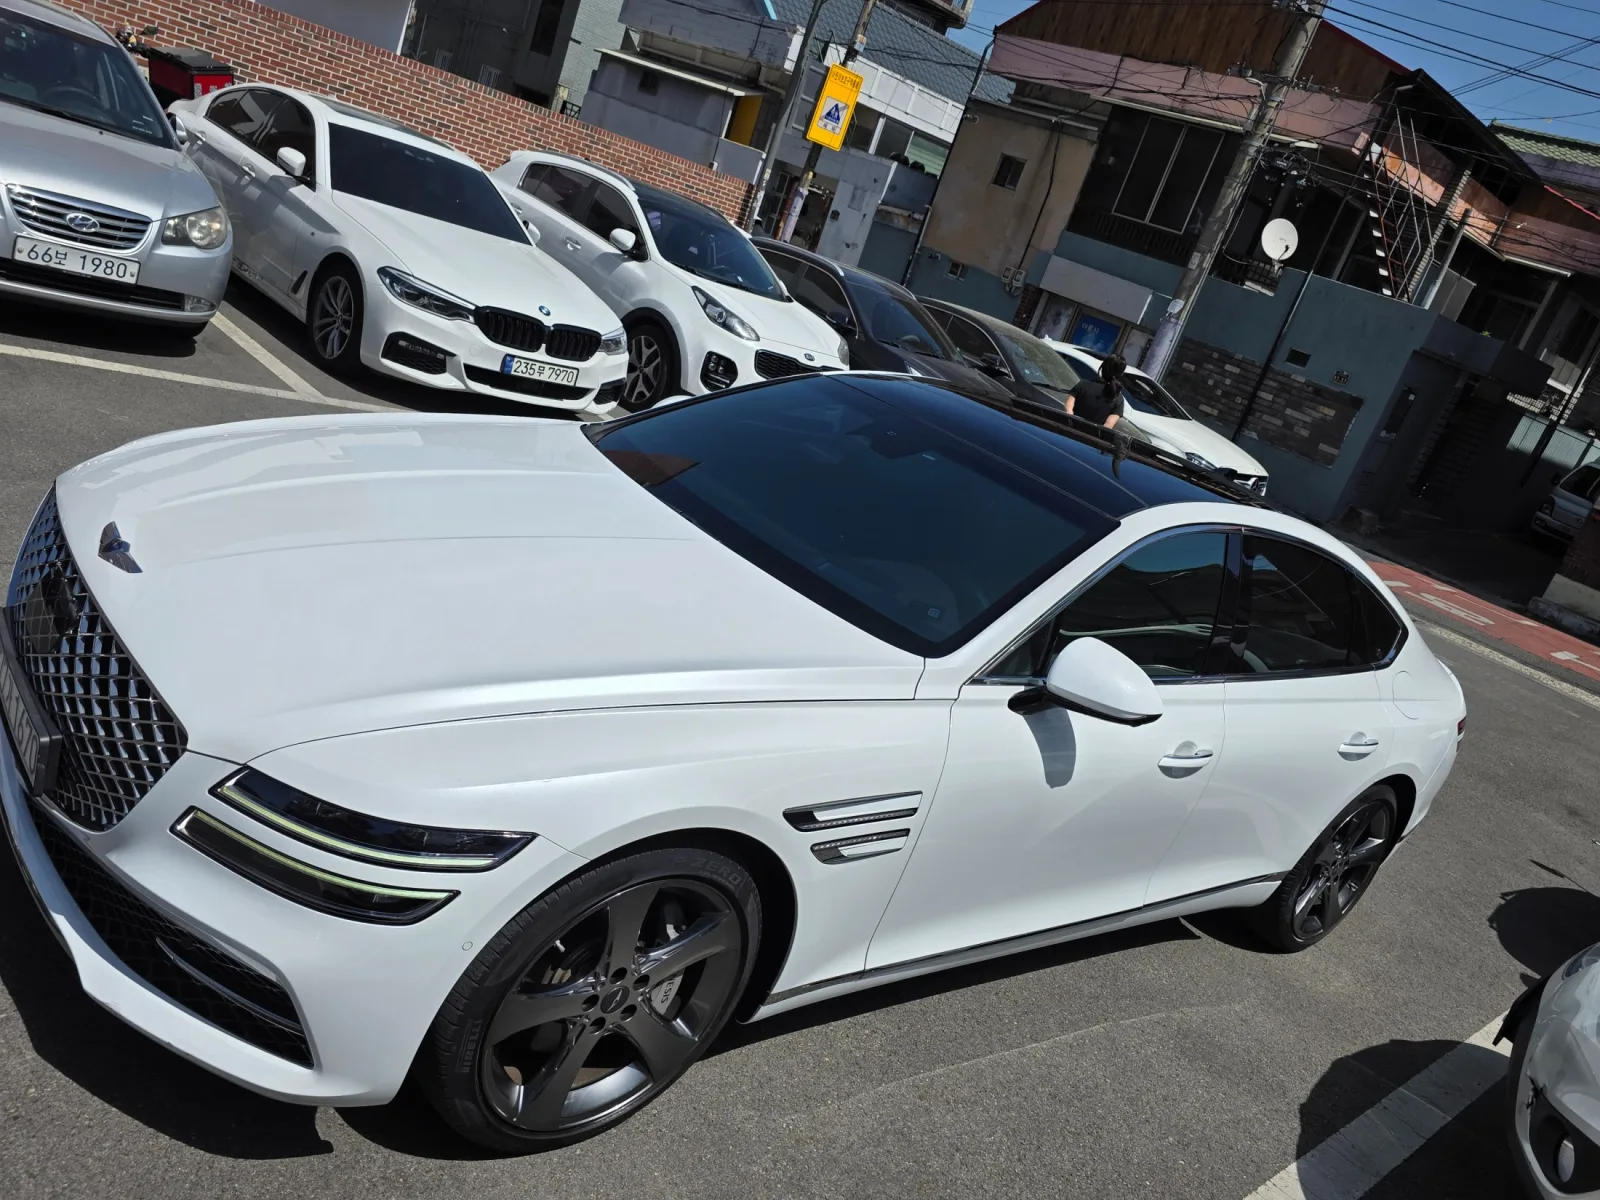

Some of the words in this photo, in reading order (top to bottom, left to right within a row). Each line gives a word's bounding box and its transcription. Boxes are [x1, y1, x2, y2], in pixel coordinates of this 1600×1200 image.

[27, 244, 68, 266] 66보
[79, 254, 128, 279] 1980
[513, 360, 546, 377] 235무
[547, 366, 575, 383] 7970
[13, 694, 39, 774] 1670
[690, 857, 743, 885] ZERO
